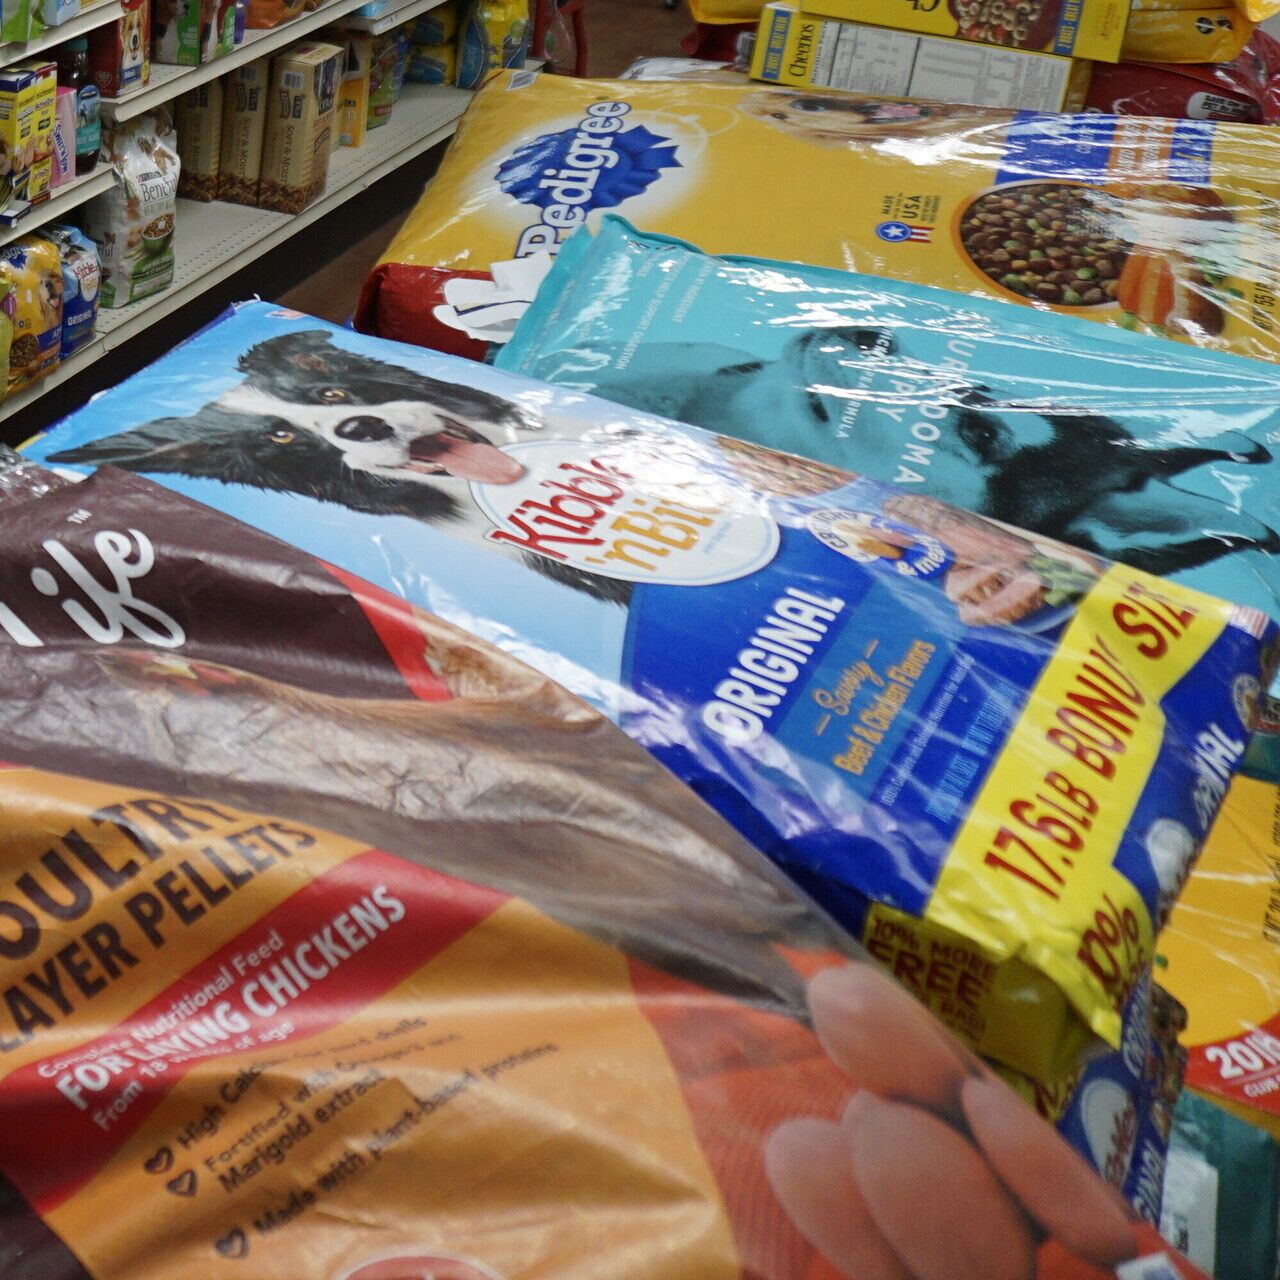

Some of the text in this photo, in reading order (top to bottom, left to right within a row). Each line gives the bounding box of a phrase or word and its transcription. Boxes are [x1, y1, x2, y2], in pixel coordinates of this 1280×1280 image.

[521, 98, 632, 263] Pedigree
[701, 587, 845, 742] ORIGINAL
[123, 817, 316, 949] PELLETS
[55, 1062, 126, 1111] FOR
[129, 1006, 244, 1072] LAYING
[241, 885, 408, 1018] CHICKENS
